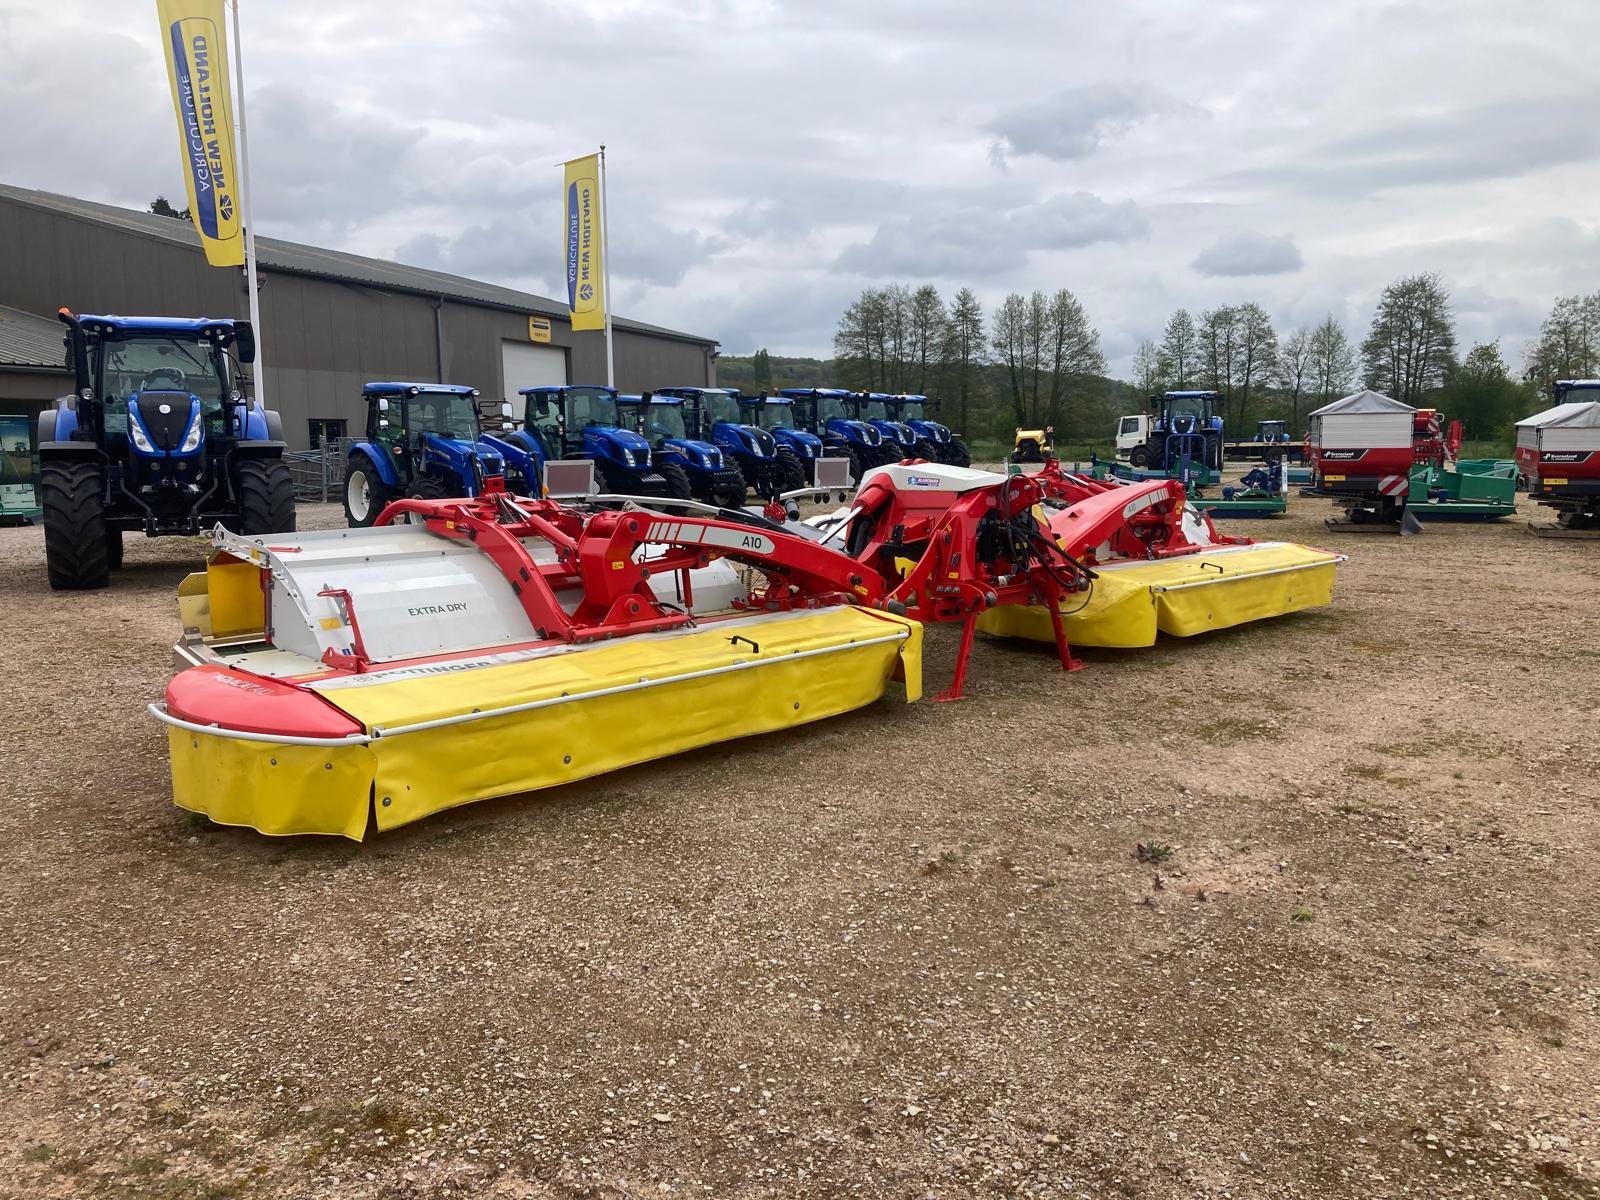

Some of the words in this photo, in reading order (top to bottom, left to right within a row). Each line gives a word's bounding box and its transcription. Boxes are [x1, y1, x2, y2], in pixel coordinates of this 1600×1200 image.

[742, 535, 762, 549] A10
[408, 605, 446, 616] EXTRA
[446, 602, 467, 612] DRY
